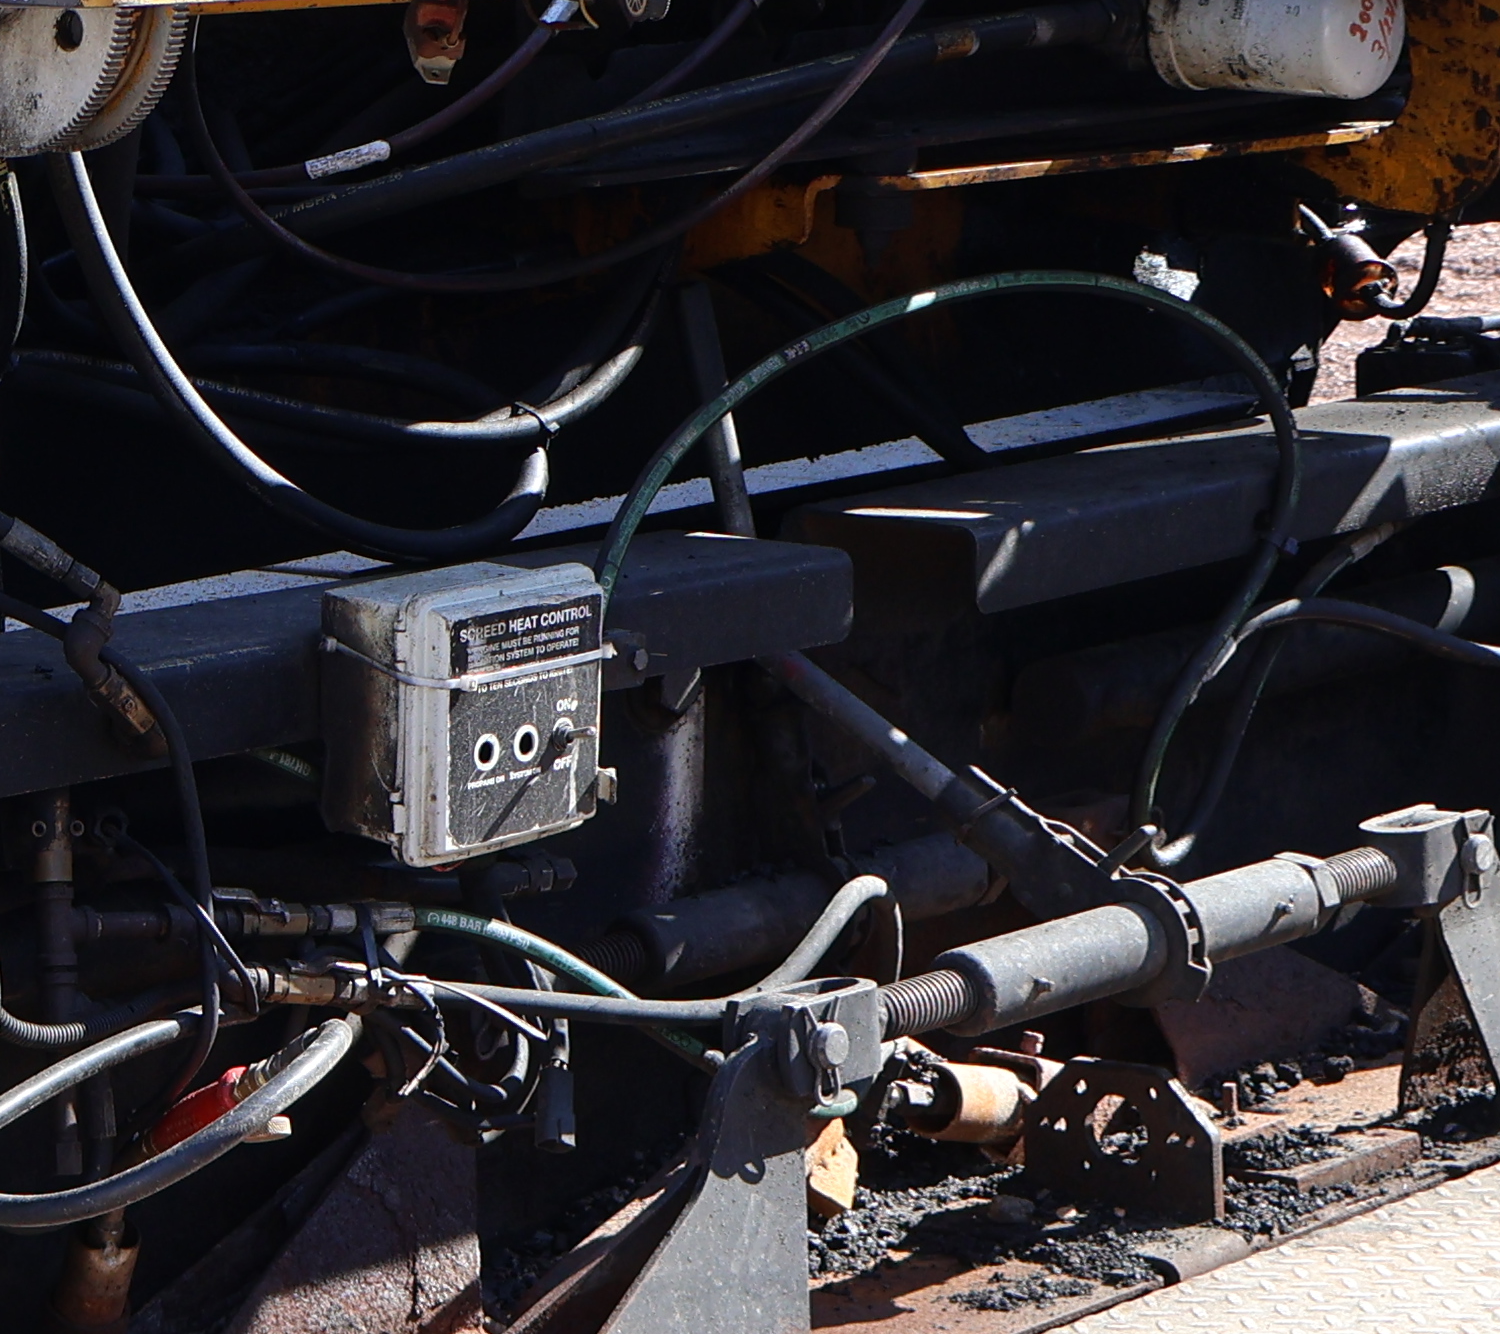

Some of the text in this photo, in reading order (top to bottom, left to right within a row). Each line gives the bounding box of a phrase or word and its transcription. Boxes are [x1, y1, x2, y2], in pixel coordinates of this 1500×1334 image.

[459, 604, 593, 643] SCREED HEAT CONTROL
[501, 637, 522, 650] MUST
[522, 636, 532, 646] BE
[533, 630, 564, 643] RUNNING
[565, 626, 580, 636] FOR
[506, 648, 534, 661] SYSTEM
[536, 645, 546, 655] TO
[477, 682, 488, 694] TO
[489, 680, 503, 691] TEN
[538, 670, 549, 681] TO
[553, 755, 573, 771] OFF
[459, 917, 482, 932] BAR
